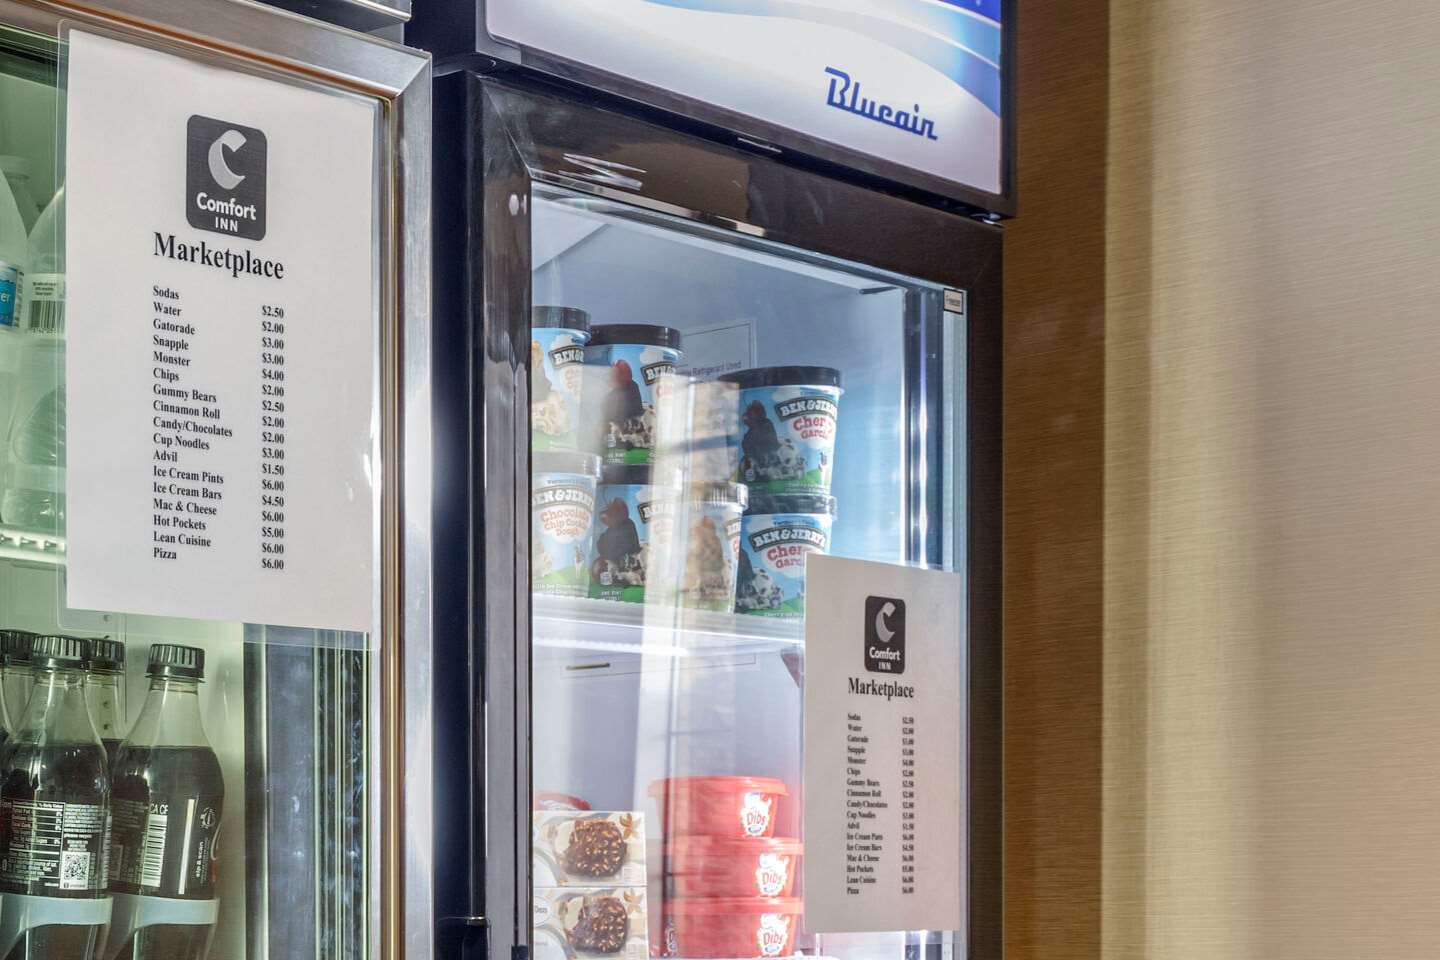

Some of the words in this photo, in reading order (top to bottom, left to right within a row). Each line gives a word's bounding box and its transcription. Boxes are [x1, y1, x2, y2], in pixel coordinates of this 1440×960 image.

[824, 66, 939, 141] Blueair
[196, 192, 257, 221] Comfort
[215, 217, 238, 232] INN
[153, 232, 284, 279] Marketplace
[153, 285, 179, 300] Sodas
[153, 302, 182, 316] Water
[262, 305, 284, 318] $2.50
[153, 318, 196, 335] Gatorade
[262, 321, 284, 334] $2.00
[153, 335, 189, 351] Snapple
[262, 337, 284, 350] $3.00
[153, 351, 191, 366] Monster
[262, 353, 284, 366] $3.00
[153, 367, 179, 383] Chips
[262, 369, 284, 381] $4.00
[153, 384, 189, 401] Gummy
[192, 389, 217, 403] Bears
[262, 385, 284, 397] $2.00
[153, 400, 199, 416] Cinnamon
[202, 407, 220, 419] Roll
[262, 401, 284, 413] $2.50
[153, 416, 233, 437] Candy/Chocolates
[262, 416, 284, 429] $2.00
[153, 433, 172, 447] Cup
[176, 436, 210, 450] Noodles
[262, 432, 284, 444] $2.00
[153, 450, 178, 462] Advil
[262, 448, 284, 460] $3.00
[153, 465, 167, 477] Ice
[169, 467, 199, 481] Cream
[202, 471, 224, 484] Pints
[262, 464, 284, 476] $1.50
[153, 482, 167, 493] Ice
[169, 484, 199, 498] Cream
[202, 488, 222, 500] Bars
[262, 479, 284, 491] $6.00
[153, 498, 173, 511] Mac
[176, 502, 184, 512] &
[186, 502, 217, 515] Cheese
[262, 495, 284, 507] $4.50
[153, 515, 170, 527] Hot
[173, 517, 206, 530] Pockets
[262, 511, 284, 523] $6.00
[153, 531, 176, 543] Lean
[178, 533, 211, 547] Cuisine
[262, 527, 284, 539] $5.00
[153, 547, 177, 559] Pizza
[262, 543, 284, 554] $6.00
[262, 558, 284, 570] $6.00
[869, 646, 901, 661] Comfort
[878, 662, 891, 671] INN
[848, 677, 914, 701] Marketplace
[747, 810, 766, 827] Dibs
[762, 870, 782, 886] Dibs
[763, 930, 783, 947] Dibs
